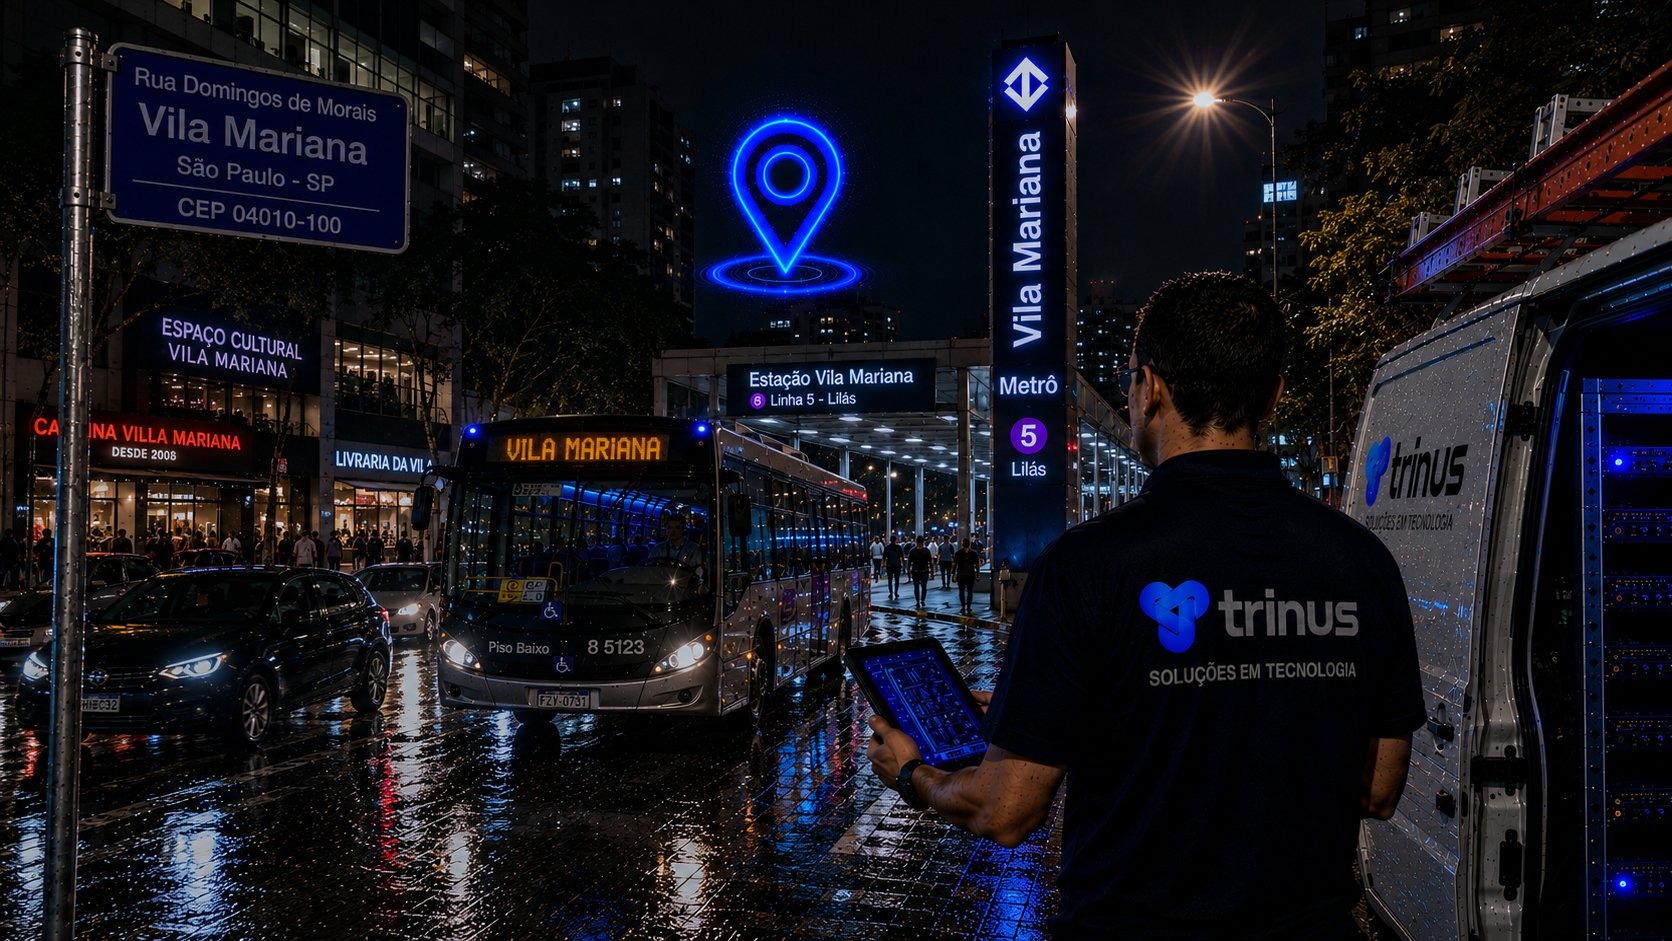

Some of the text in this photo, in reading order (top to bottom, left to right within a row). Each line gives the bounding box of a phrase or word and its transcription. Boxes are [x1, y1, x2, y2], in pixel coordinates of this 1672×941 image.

[135, 67, 376, 122] Rua Domingos de Morais
[139, 102, 368, 166] Vila Mariana
[177, 156, 219, 178] São
[227, 162, 285, 187] Paulo
[307, 173, 335, 193] SP
[178, 198, 342, 234] CEP 04010-100
[1012, 131, 1042, 348] Vila Mariana
[162, 317, 303, 361] ESPAÇO CULTURAL
[168, 342, 289, 379] VILA MARIANA
[749, 368, 914, 391] Estação Vila Mariana
[999, 375, 1058, 396] Metrô
[770, 394, 803, 406] Linha
[806, 394, 815, 406] 5
[828, 391, 857, 405] Lilás
[34, 417, 241, 452] CAINA VILLA MARIANA
[506, 437, 556, 461] VILA
[1020, 424, 1038, 448] 5
[111, 446, 177, 461] DESDE 2008
[336, 450, 390, 471] LIVRARIA
[392, 455, 409, 473] DA
[1389, 437, 1469, 499] trinus
[1011, 460, 1047, 478] Lilás
[1218, 588, 1359, 637] trinus
[488, 639, 645, 655] Piso Baixo 8 5123
[1149, 661, 1357, 687] SOLUÇÕES EM TECNOLOGIA
